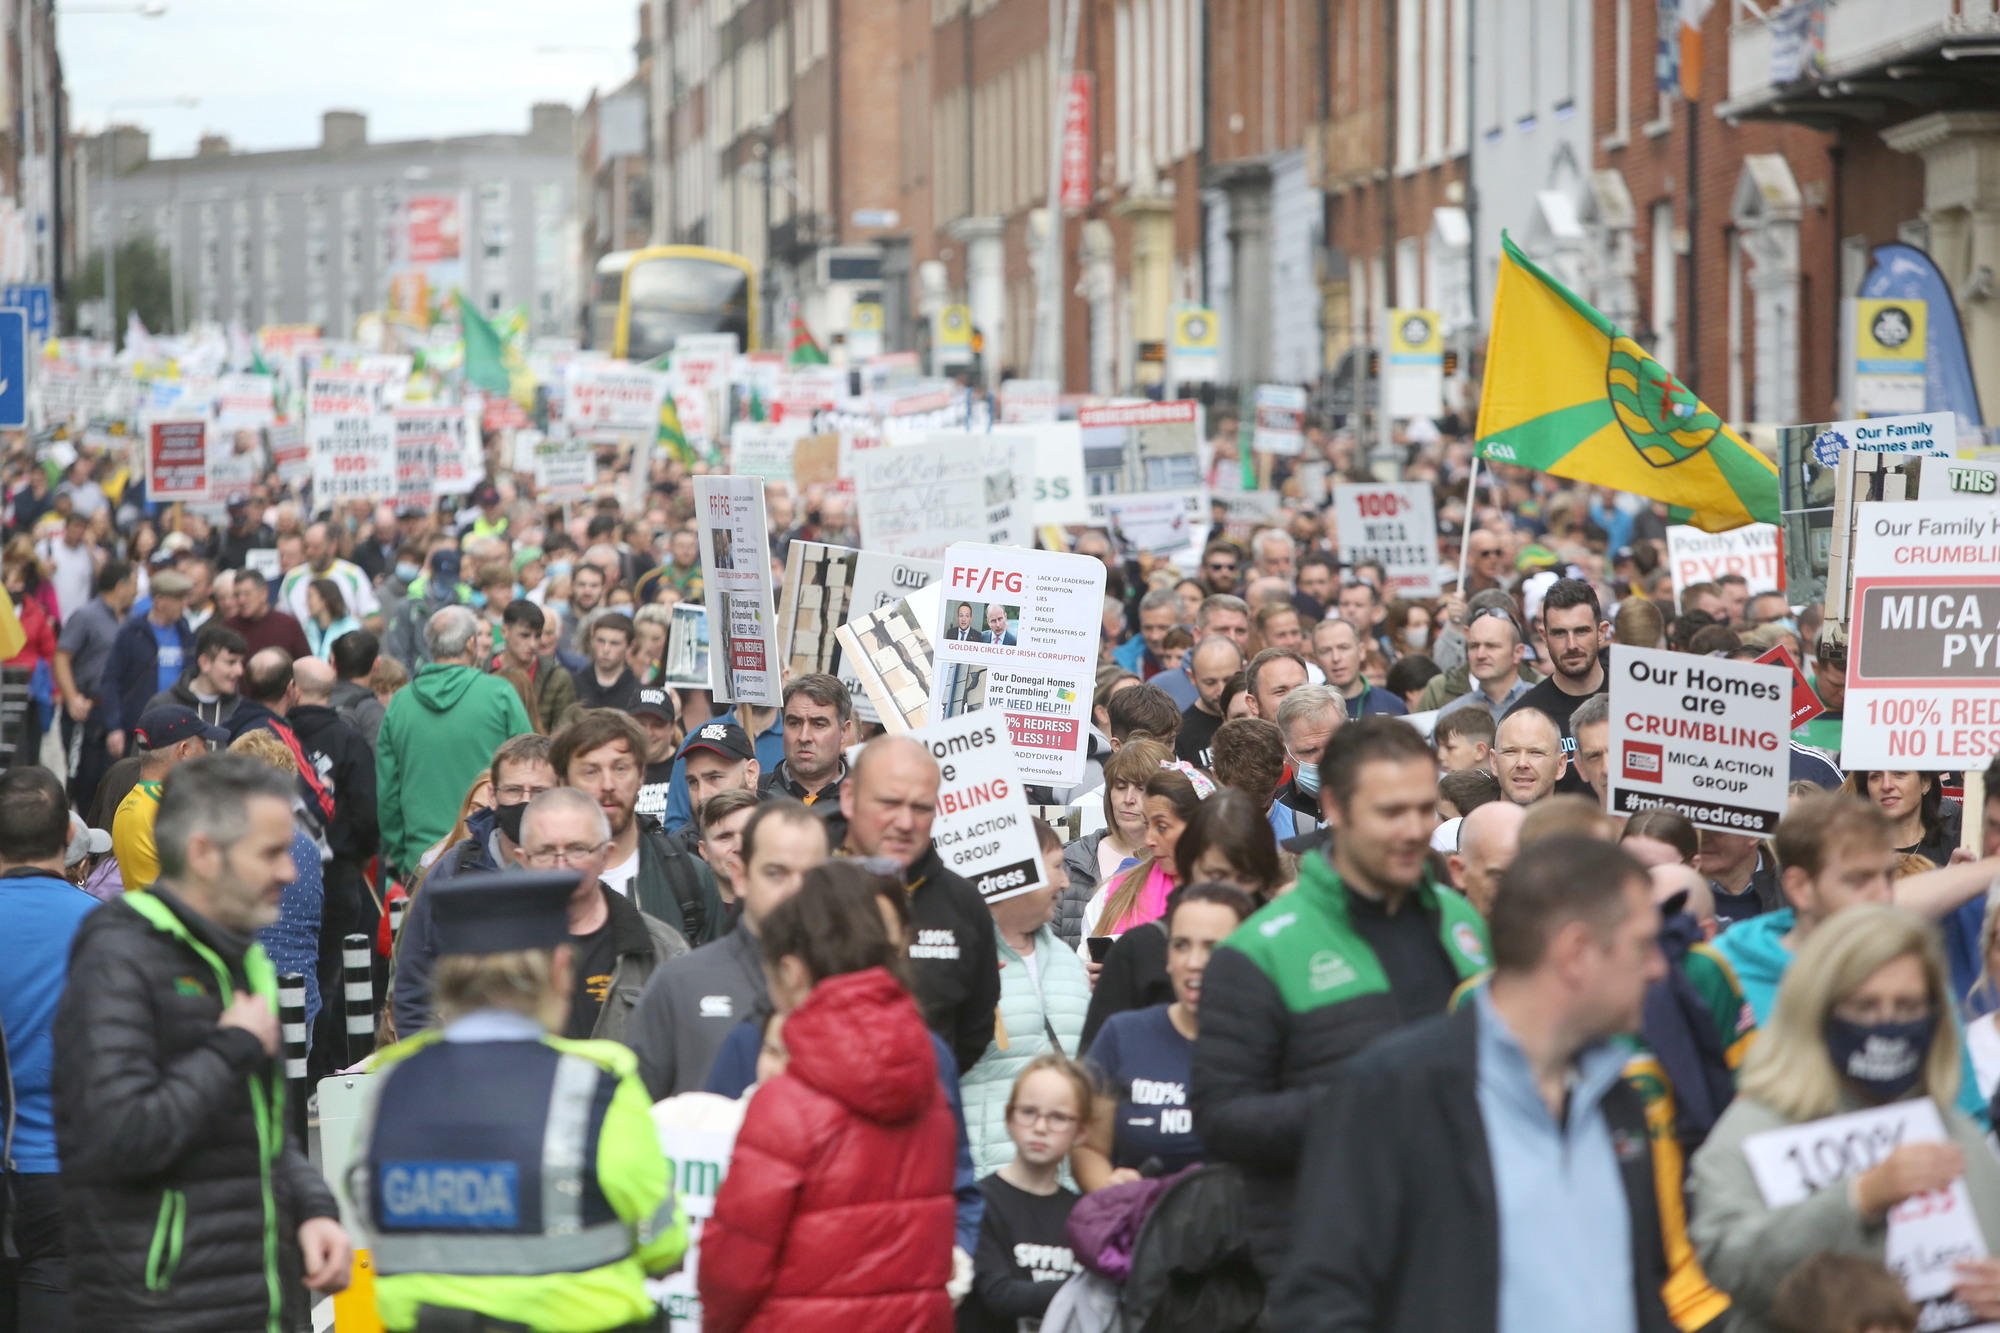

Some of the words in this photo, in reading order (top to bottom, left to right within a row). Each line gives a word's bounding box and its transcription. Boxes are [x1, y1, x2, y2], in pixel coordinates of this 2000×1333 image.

[1856, 427, 1882, 440] Our
[1886, 422, 1933, 438] Family
[1911, 438, 1934, 450] are
[1949, 467, 1996, 494] THIS
[709, 493, 730, 519] FF/FG
[1356, 493, 1411, 517] 100%
[1874, 519, 1914, 537] Our
[1918, 517, 1986, 539] Family
[1894, 545, 2000, 564] CRUMBLI
[892, 564, 928, 588] Our
[952, 566, 1023, 593] FF/FG
[1680, 553, 1777, 586] PYRIT
[1035, 585, 1073, 594] CORRUPTION
[1061, 577, 1095, 586] LEADERSHIP
[735, 599, 749, 610] Donegal
[749, 600, 760, 609] Homes
[1880, 595, 1983, 630] MICA
[737, 624, 747, 634] NEED
[1030, 626, 1077, 636] PUPPETMASTERS
[737, 656, 743, 667] NO
[948, 643, 979, 653] GOLDEN
[980, 646, 1004, 655] CIRCLE
[1005, 648, 1016, 656] OF
[1017, 650, 1036, 658] IRISH
[1037, 651, 1086, 663] CORRUPTION
[1942, 634, 2000, 669] PY
[989, 685, 1004, 693] are
[1011, 674, 1045, 686] Donegal
[1047, 677, 1075, 689] Homes
[1629, 660, 1678, 686] Our
[1686, 668, 1780, 701] Homes
[989, 697, 1004, 707] WE
[1006, 698, 1033, 710] NEED
[1035, 700, 1071, 714] HELP!!!
[1681, 695, 1726, 716] are
[1796, 704, 1812, 717] MICA
[1866, 698, 1941, 726] 100%
[1023, 718, 1072, 733] REDRESS
[1625, 712, 1778, 751] CRUMBLING
[924, 727, 996, 759] omes
[1017, 732, 1044, 744] LESS
[1888, 730, 1927, 757] NO
[1936, 730, 2000, 757] LESS
[1013, 751, 1063, 762] ADDYDIVER4
[1668, 751, 1708, 769] MICA
[1713, 758, 1774, 778] ACTION
[1692, 775, 1748, 793] GROUP
[935, 779, 1009, 817] BLING
[937, 831, 963, 849] ICA
[967, 814, 1018, 838] ACTION
[953, 841, 1001, 865] GROUP
[917, 929, 956, 945] 100%
[1131, 1078, 1186, 1106] 100%
[1160, 1109, 1192, 1134] NO
[384, 1166, 512, 1216] GARDA
